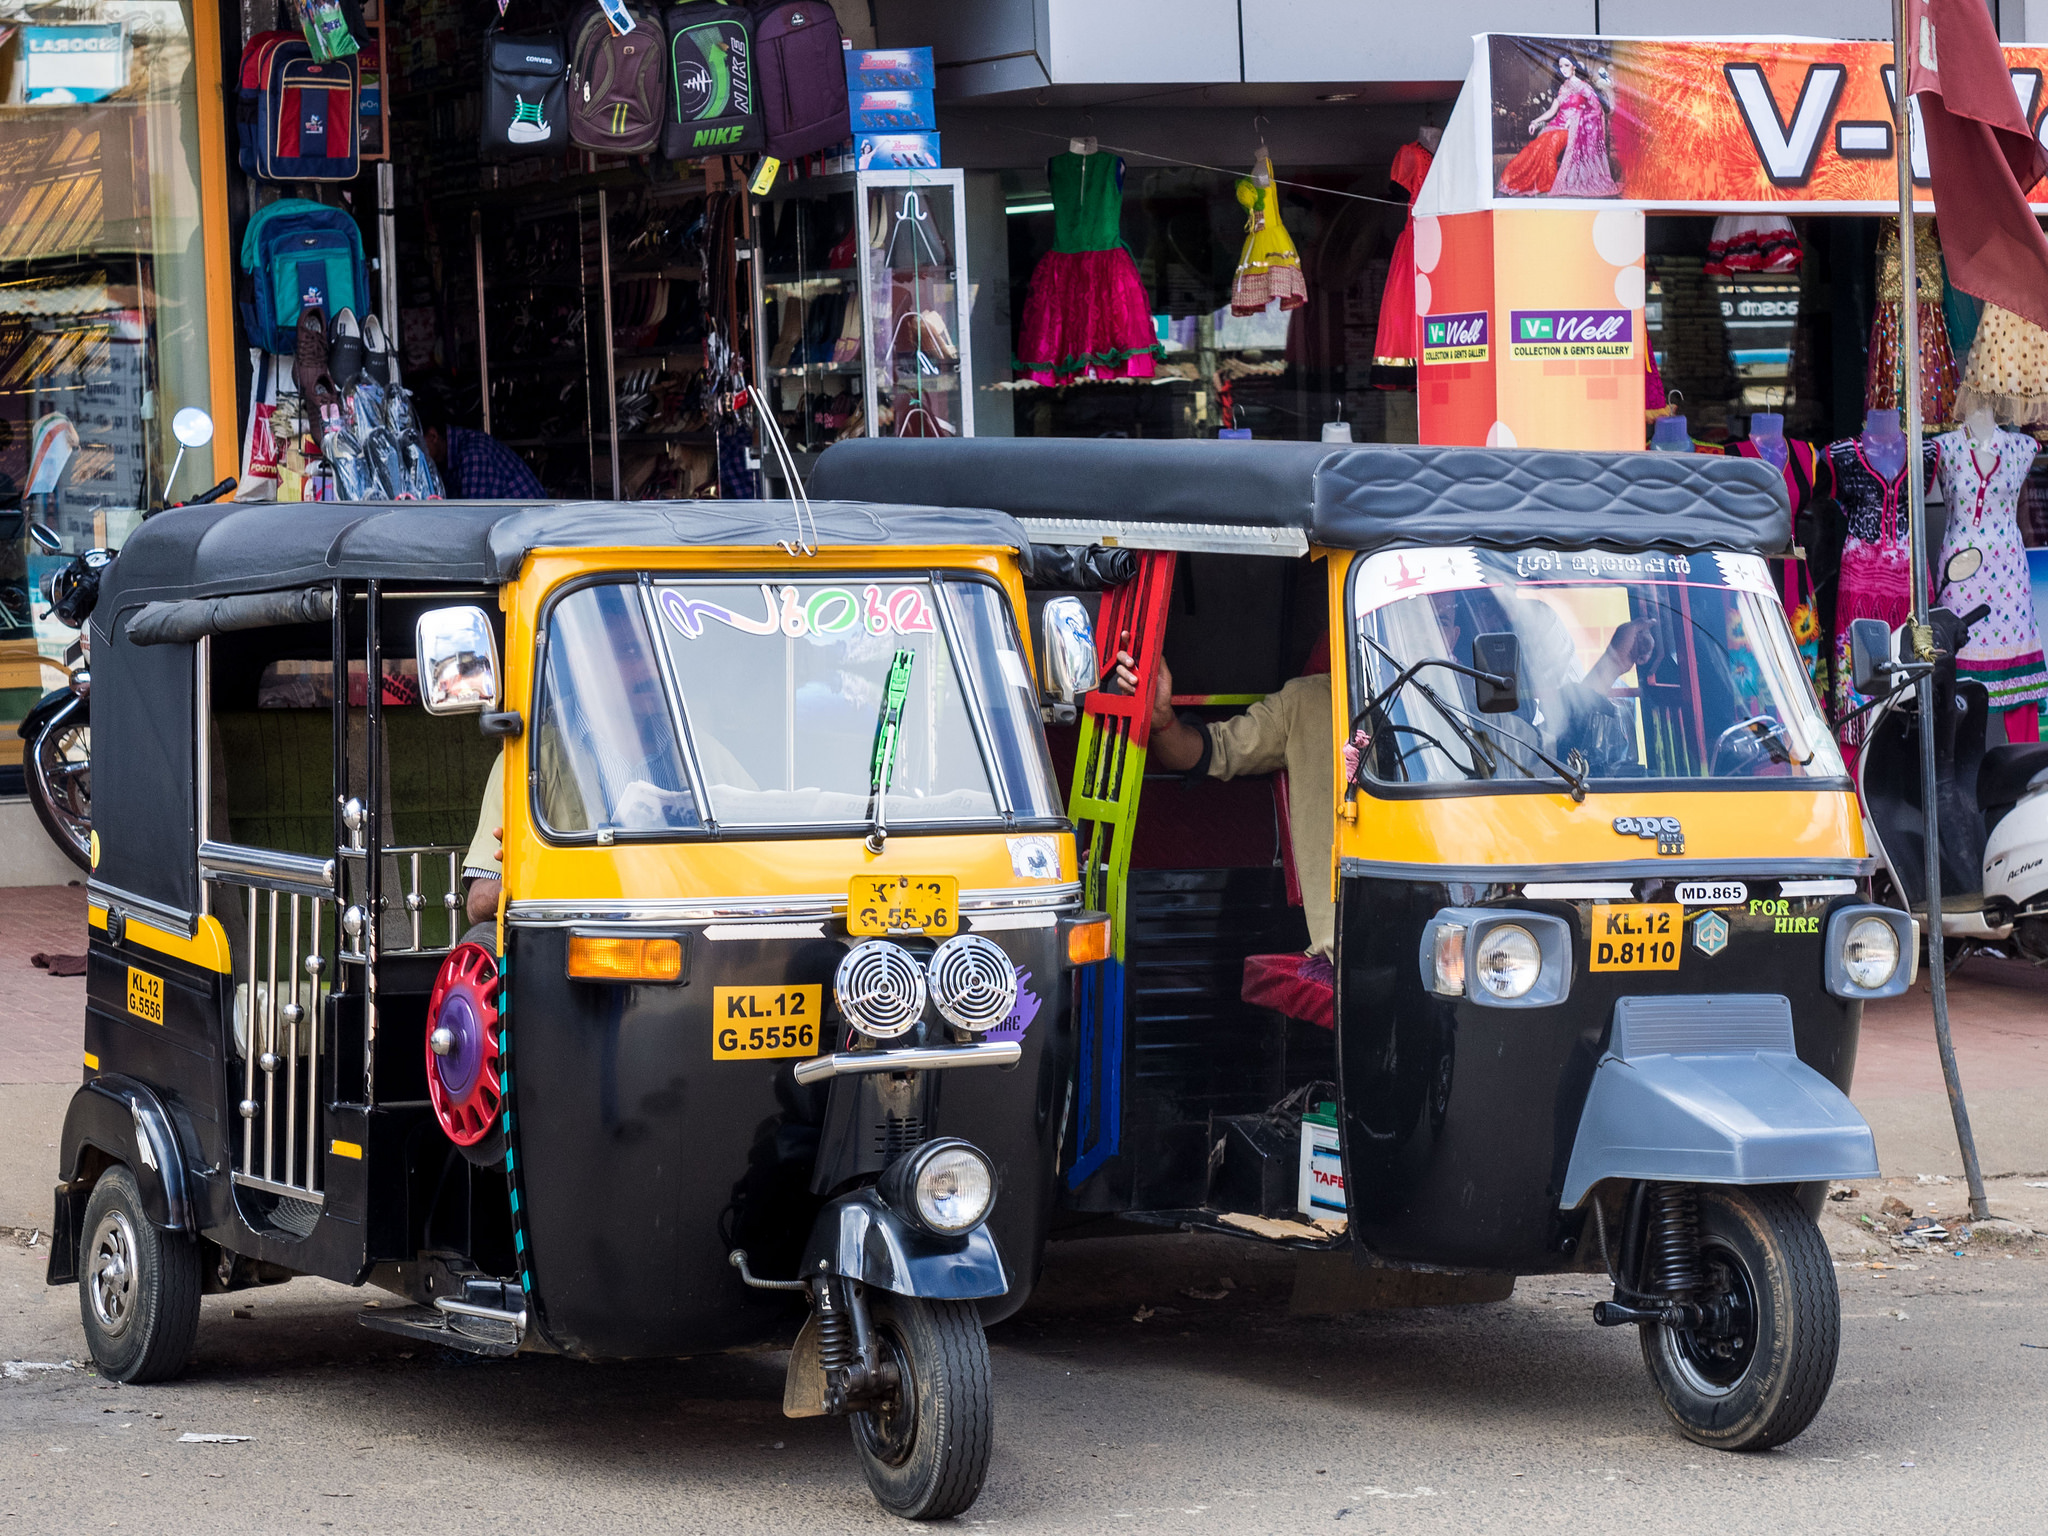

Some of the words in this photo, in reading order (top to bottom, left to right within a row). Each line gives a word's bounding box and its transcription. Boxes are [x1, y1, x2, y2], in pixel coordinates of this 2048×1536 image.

[860, 54, 897, 69] Paragon
[730, 37, 749, 114] NIKE
[860, 95, 897, 109] Paragon
[693, 125, 744, 147] NIKE
[1426, 351, 1448, 361] COLLECTION
[1454, 350, 1467, 359] GENTS
[1468, 348, 1486, 358] GALLERY
[1514, 347, 1561, 356] COLLECTION
[1563, 347, 1568, 355] &
[1570, 346, 1595, 355] GENTS
[1597, 346, 1630, 355] GALLERY
[1615, 817, 1680, 836] ape
[2007, 859, 2042, 882] Activa
[1682, 887, 1741, 899] MD.865
[1750, 899, 1790, 916] FOR
[1607, 913, 1669, 935] KL.12
[1774, 917, 1818, 933] HIRE
[1597, 942, 1675, 964] D.8110
[133, 973, 159, 998] KL.12
[130, 993, 161, 1020] G.5556
[727, 992, 805, 1018] KL.12
[990, 1015, 1021, 1032] IRE
[718, 1024, 813, 1052] G.5556
